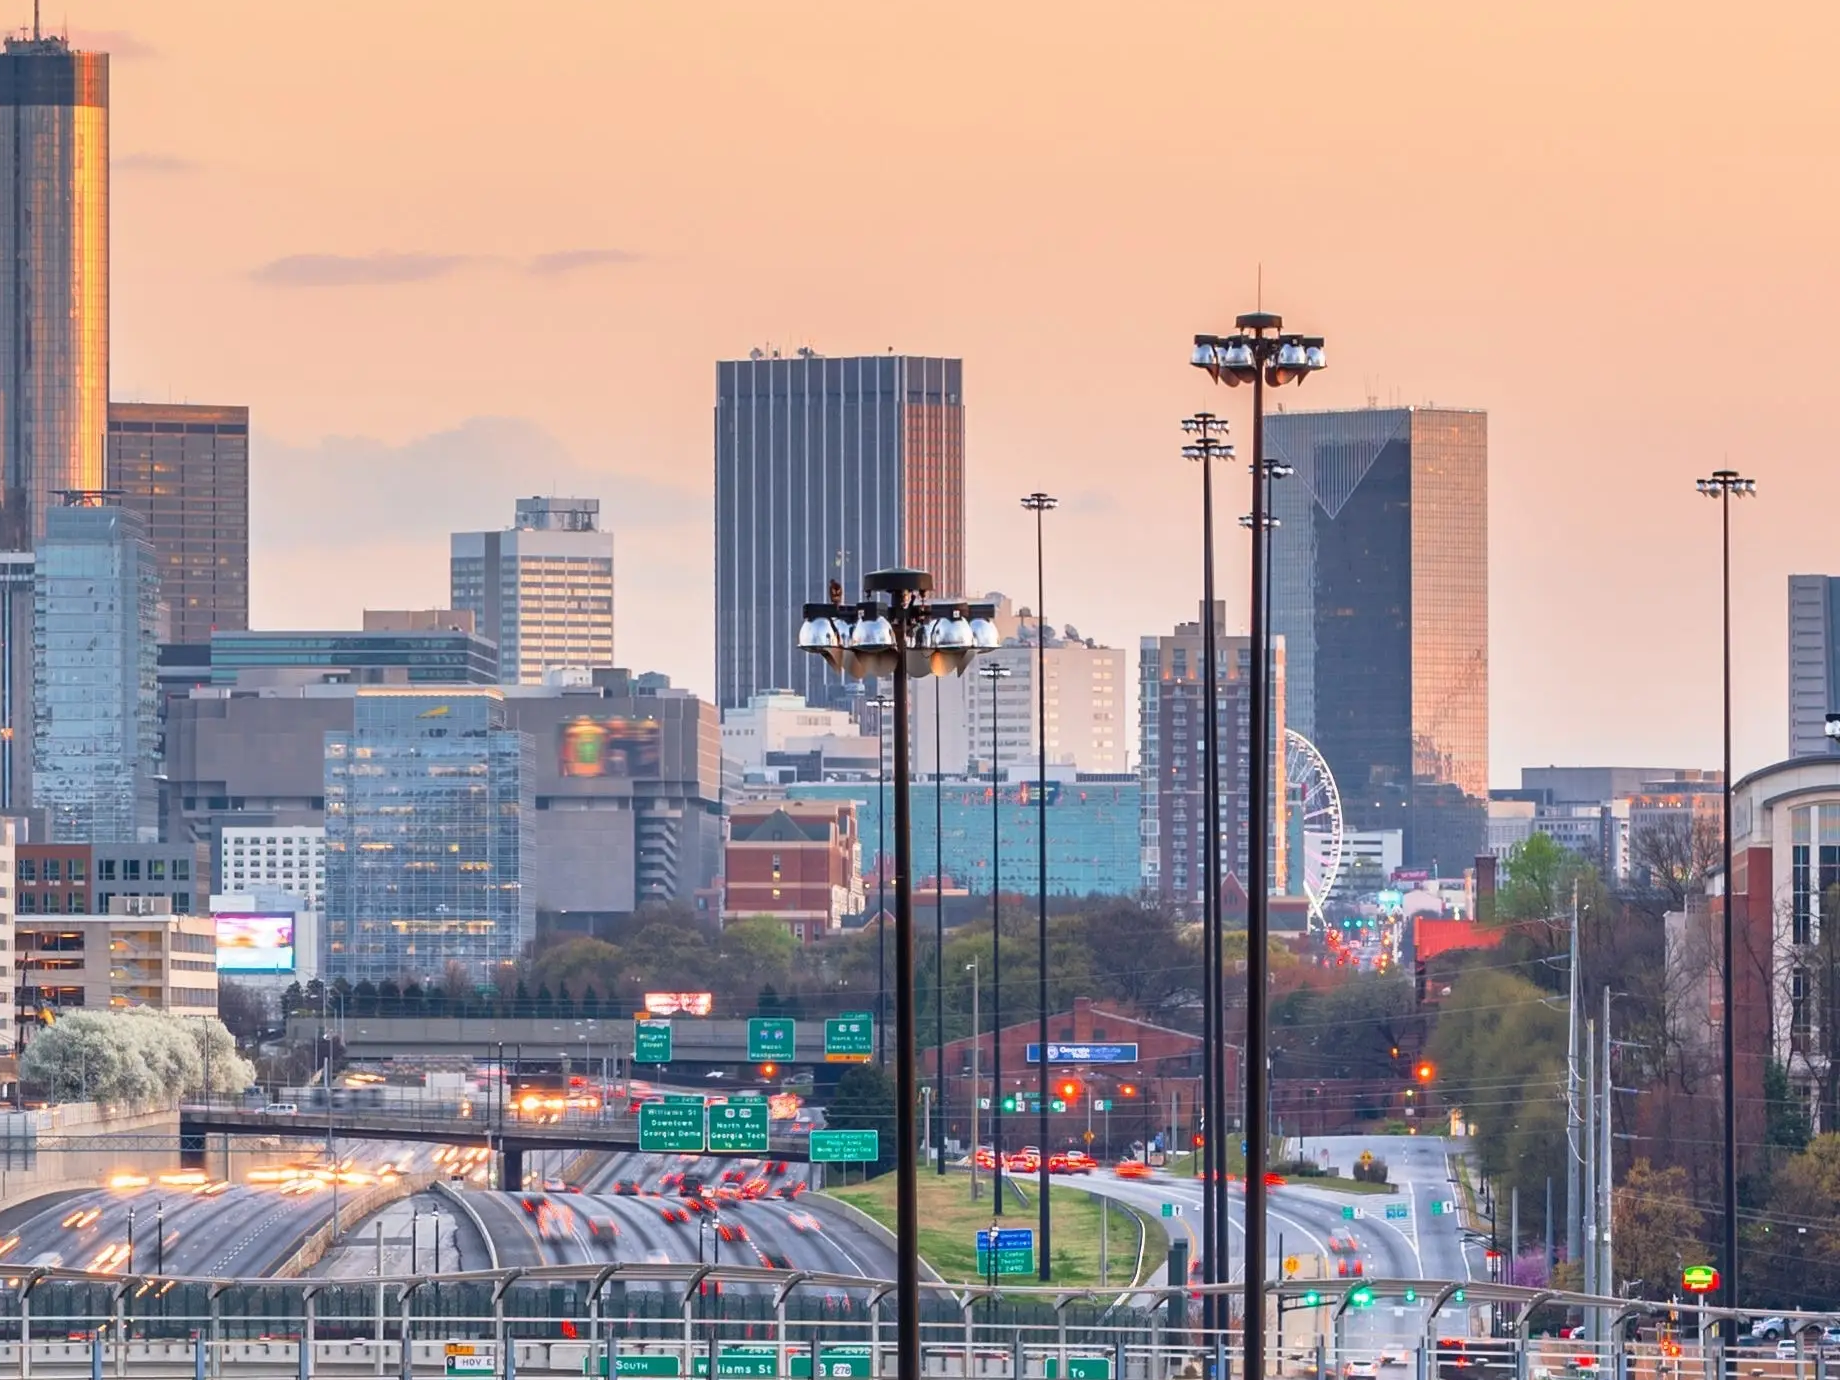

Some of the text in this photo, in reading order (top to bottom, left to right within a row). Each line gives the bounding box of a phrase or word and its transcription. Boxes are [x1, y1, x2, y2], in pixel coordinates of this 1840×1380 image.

[648, 1108, 697, 1116] Williams St
[651, 1119, 693, 1127] Downtown
[643, 1130, 675, 1138] Georgia
[711, 1132, 743, 1140] Georgia
[462, 1358, 481, 1366] HOV
[616, 1360, 648, 1370] SOUTH
[698, 1364, 772, 1374] Wliams St
[834, 1366, 851, 1375] 278
[1071, 1368, 1085, 1378] To
